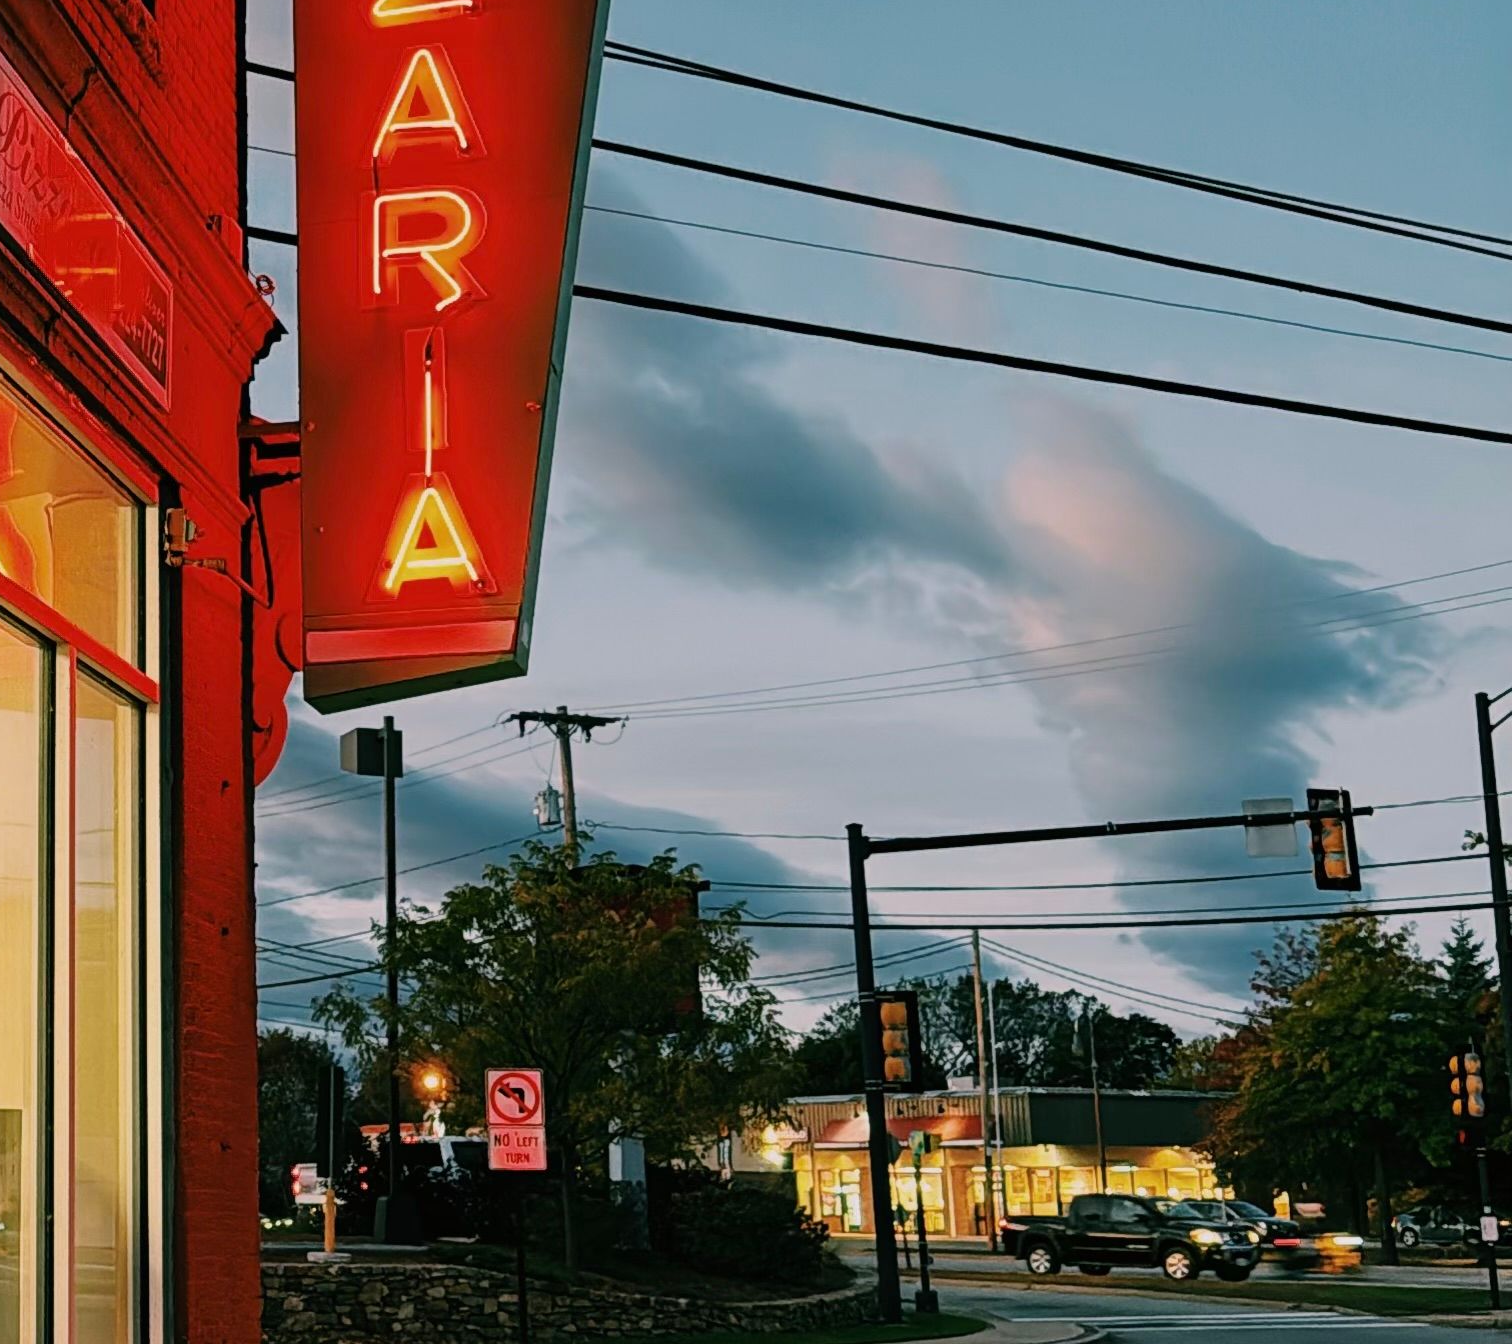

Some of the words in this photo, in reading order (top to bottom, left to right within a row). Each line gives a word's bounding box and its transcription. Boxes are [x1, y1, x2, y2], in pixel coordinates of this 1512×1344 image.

[494, 1134, 510, 1147] NO
[516, 1136, 539, 1148] LEFT
[505, 1152, 530, 1164] TURN
